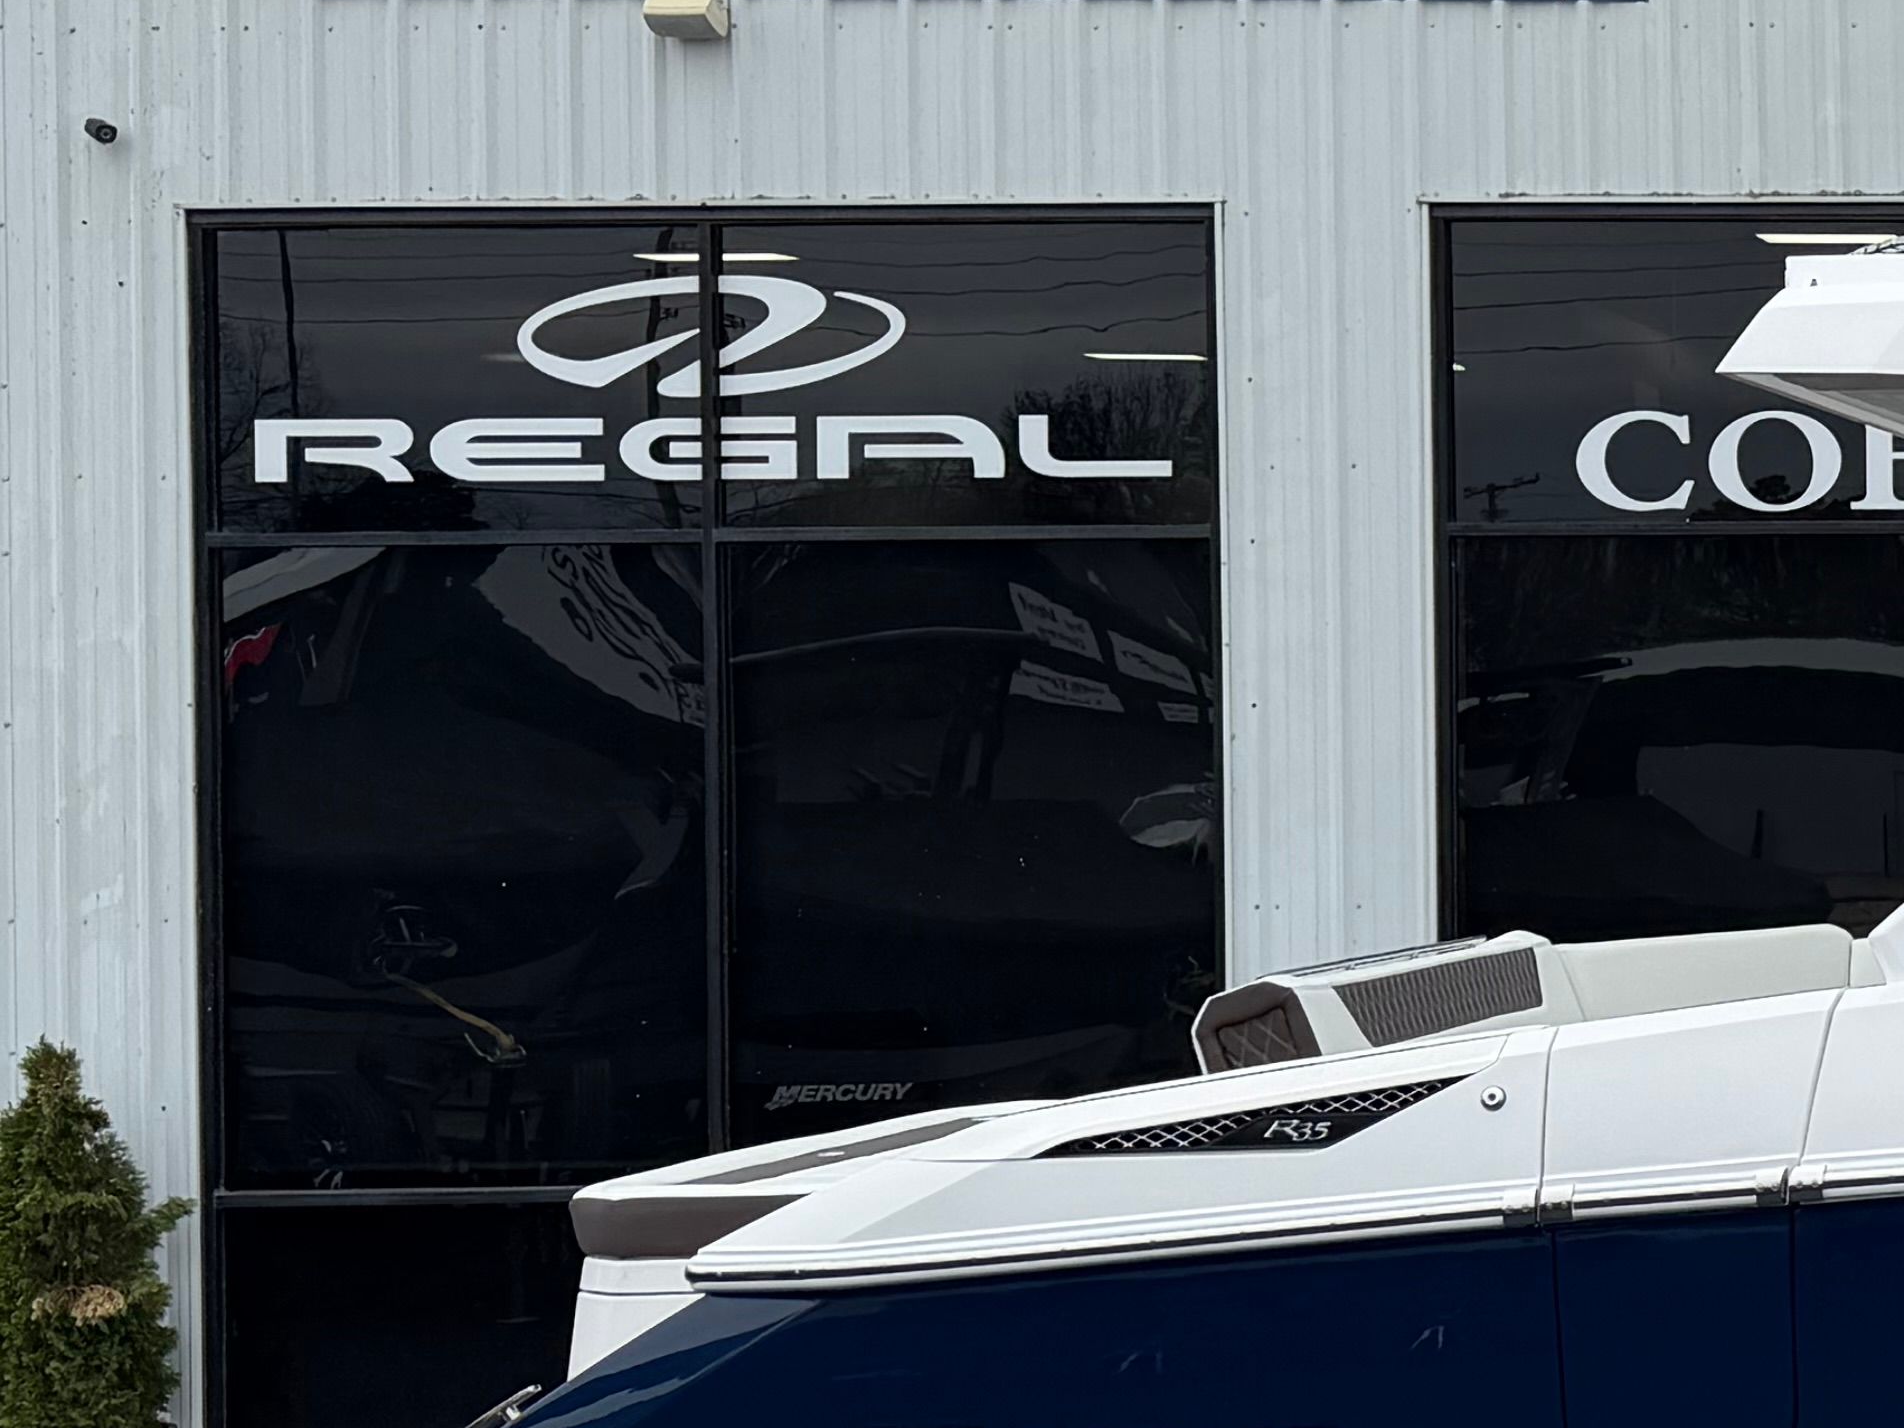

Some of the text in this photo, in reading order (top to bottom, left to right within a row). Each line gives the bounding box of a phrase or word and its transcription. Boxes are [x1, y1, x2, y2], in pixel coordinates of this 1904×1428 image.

[253, 414, 1174, 484] REGAL
[764, 1082, 914, 1111] MERCURY
[1263, 1119, 1332, 1142] R35
